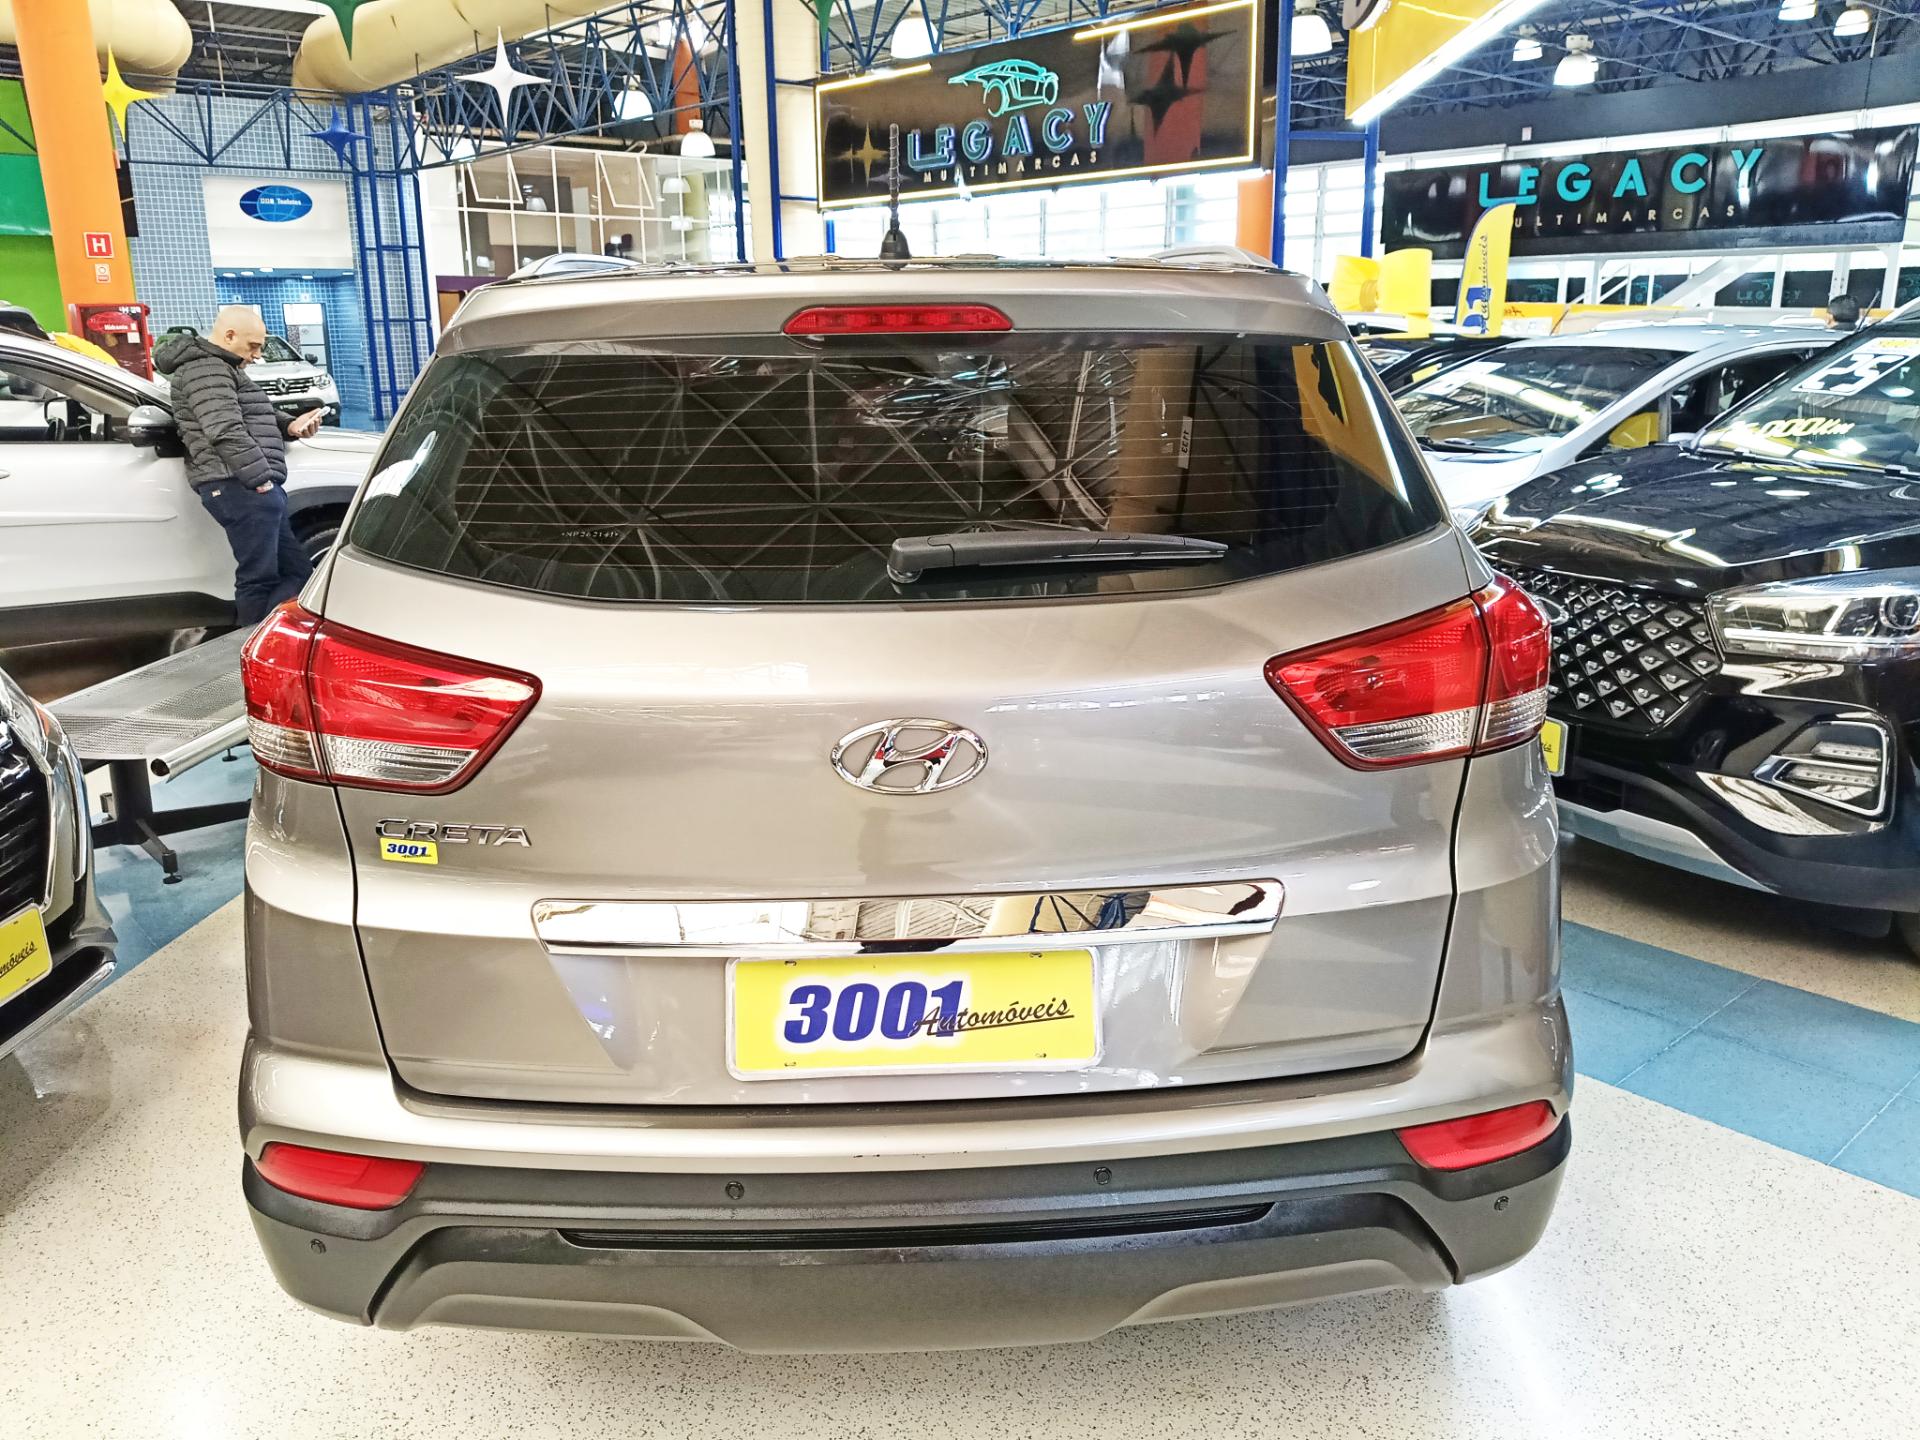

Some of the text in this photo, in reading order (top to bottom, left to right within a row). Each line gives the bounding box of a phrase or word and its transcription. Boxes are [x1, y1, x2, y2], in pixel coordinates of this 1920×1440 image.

[907, 102, 1112, 171] LEGACY
[923, 151, 1097, 183] MULTIMARCAS
[1479, 148, 1763, 207] LEGACY
[1515, 205, 1735, 228] ULTIMARCAS
[92, 237, 107, 253] H
[375, 818, 532, 848] CRETA
[387, 843, 427, 856] 3001
[784, 981, 1072, 1043] 3001 Automóveis
